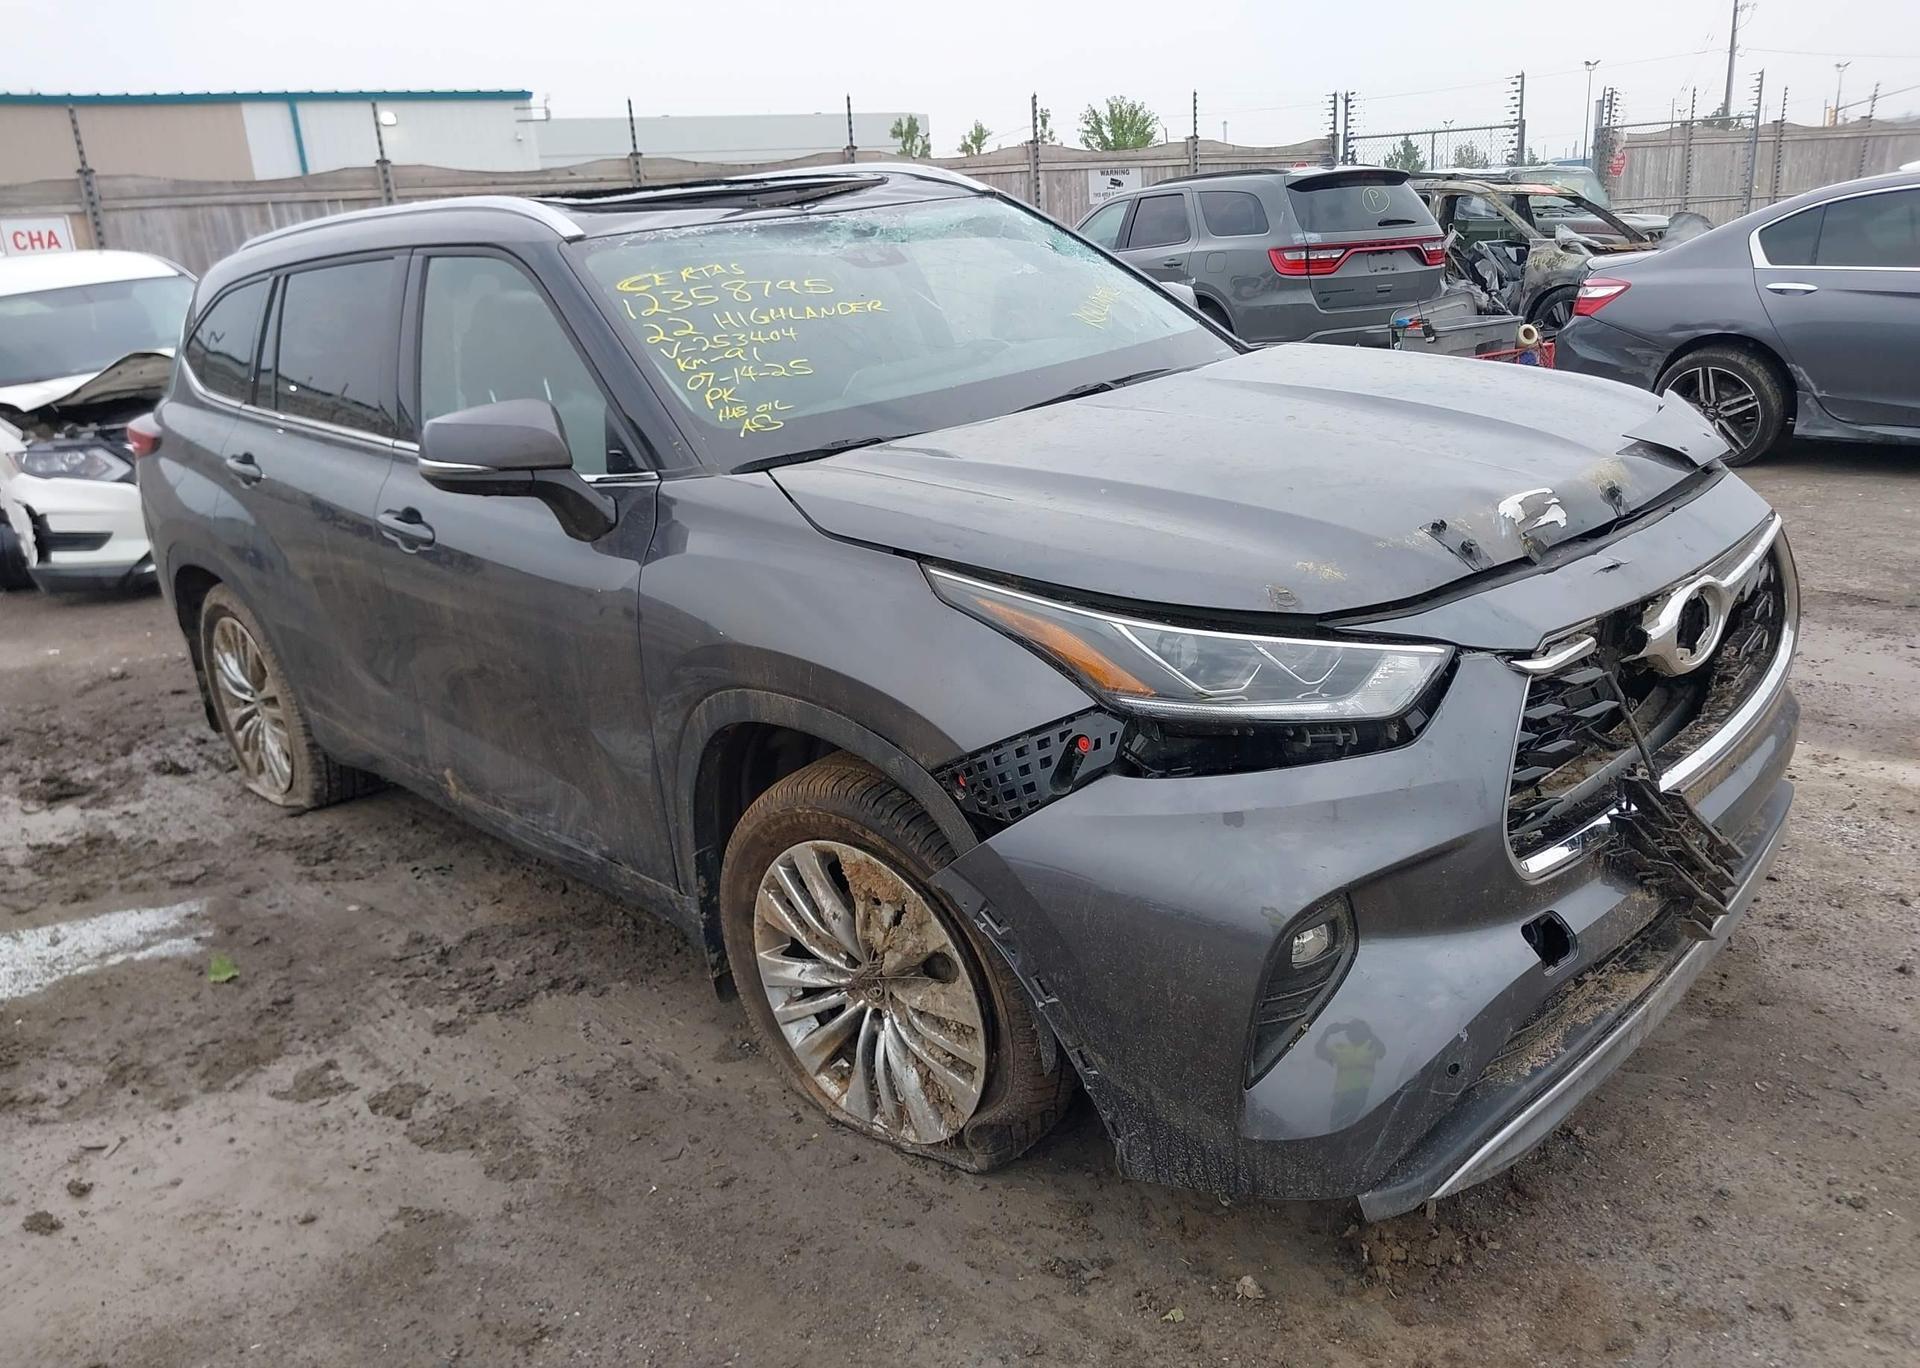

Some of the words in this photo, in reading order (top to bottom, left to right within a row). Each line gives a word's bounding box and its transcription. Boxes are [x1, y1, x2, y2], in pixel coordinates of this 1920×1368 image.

[12, 230, 61, 250] CHA
[616, 263, 745, 291] CERTAS
[622, 279, 834, 319] 12358795
[644, 318, 703, 343] 22
[713, 300, 888, 329] HIGHLANDER
[705, 387, 746, 409] PK
